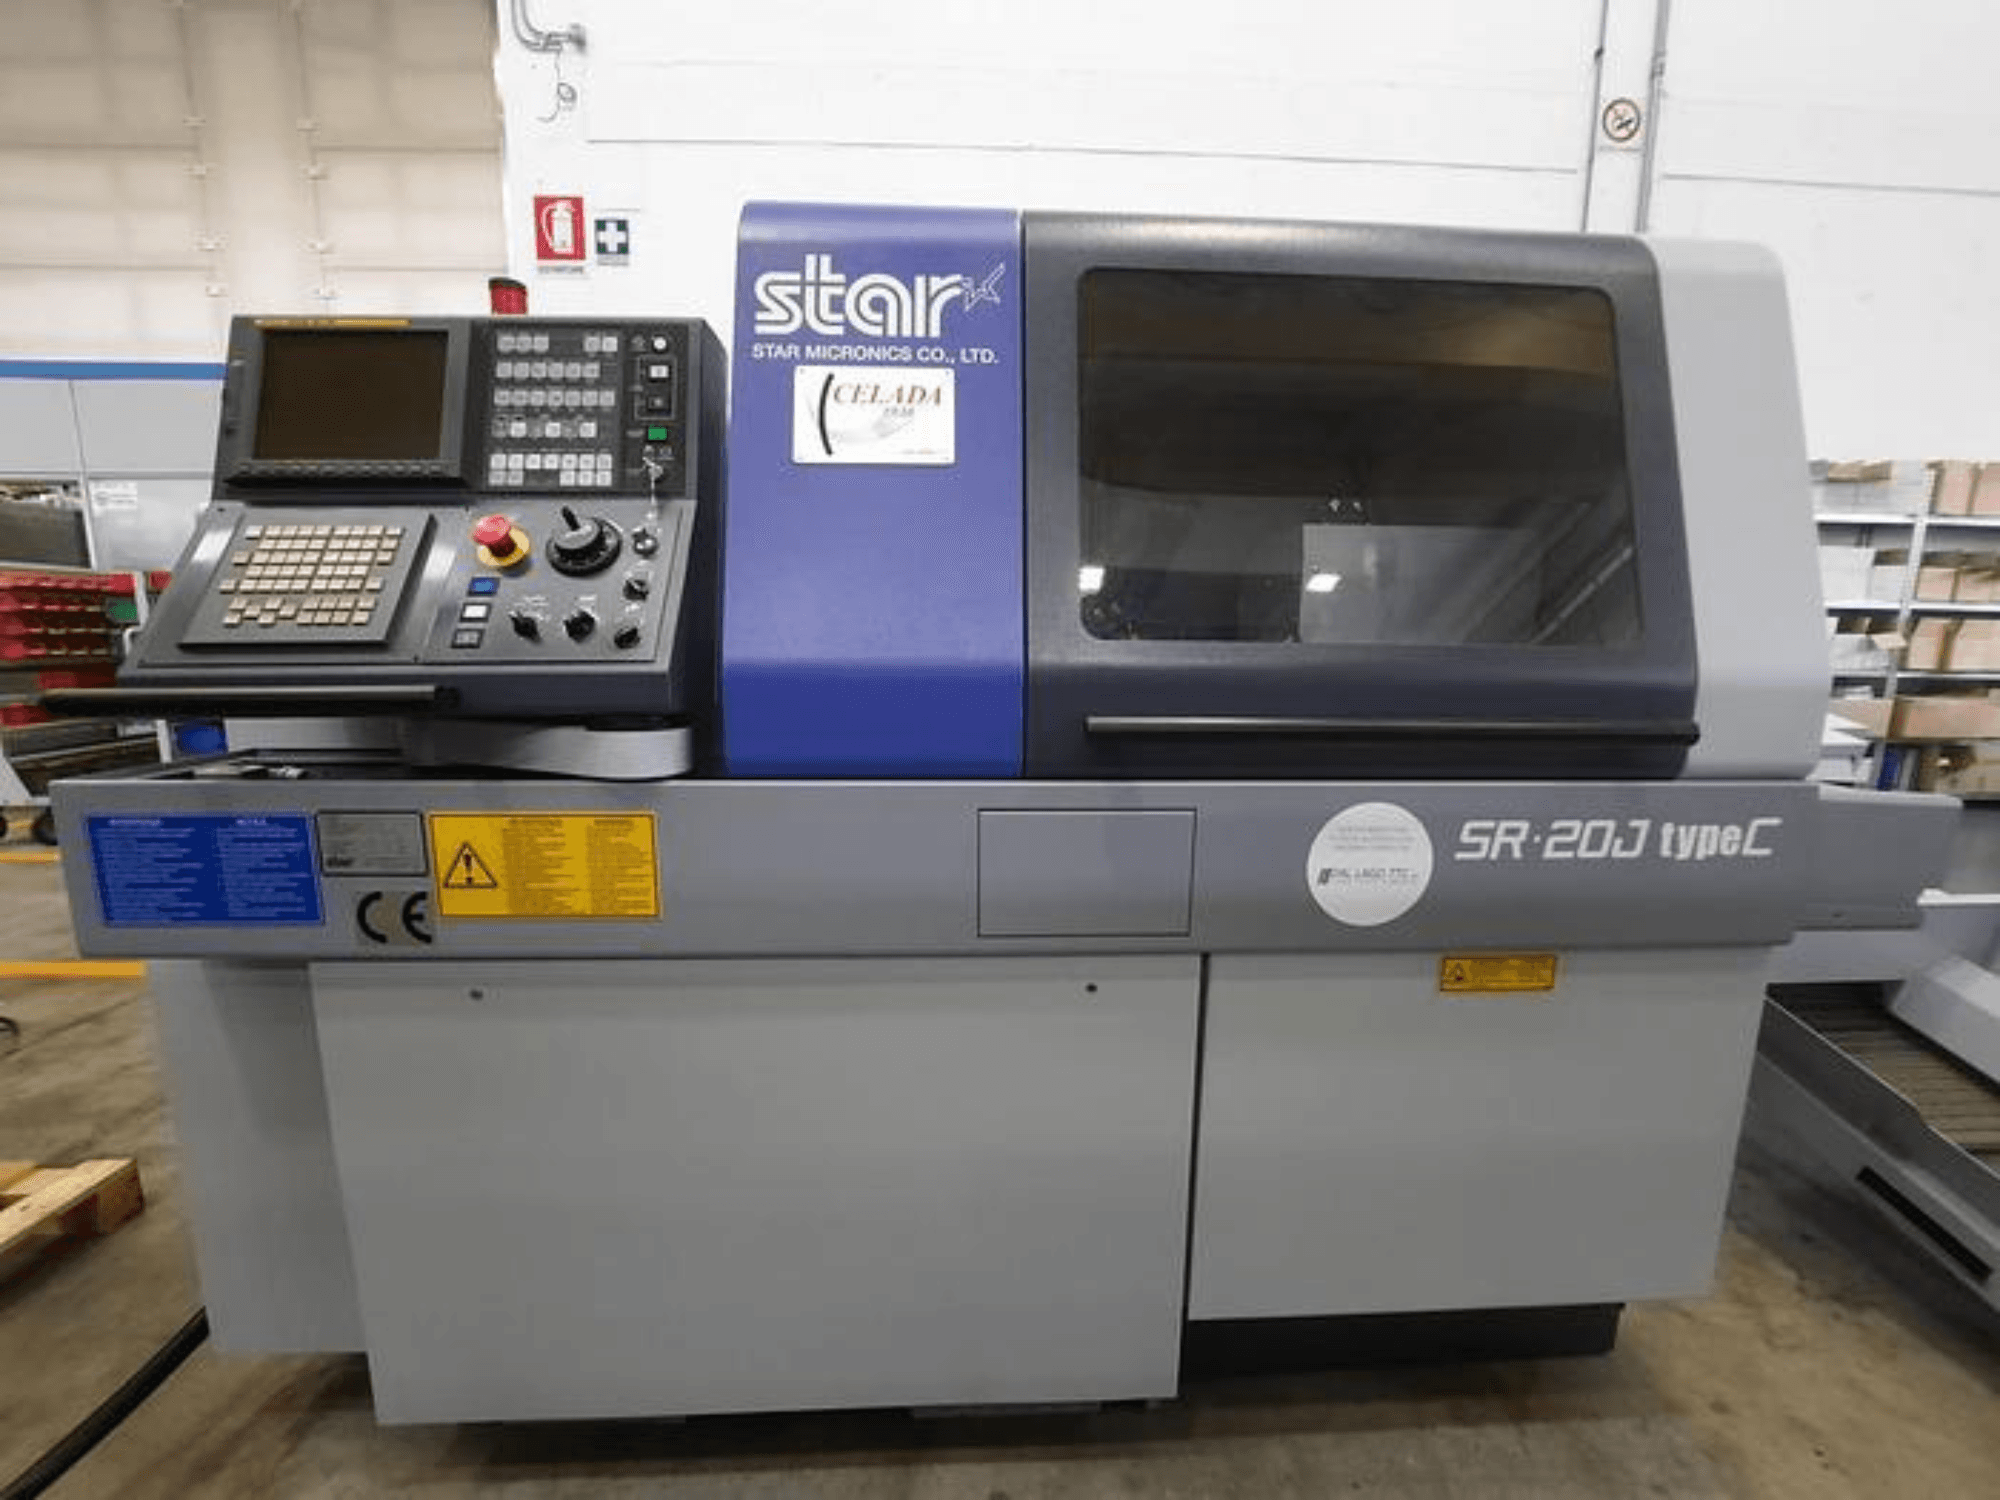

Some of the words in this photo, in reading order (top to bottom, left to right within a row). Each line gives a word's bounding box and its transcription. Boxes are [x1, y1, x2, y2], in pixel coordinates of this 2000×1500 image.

[754, 254, 962, 338] star
[752, 343, 800, 359] STAR
[804, 344, 912, 362] MICRONICS
[917, 346, 955, 364] CO.,
[960, 347, 999, 364] LTD.
[834, 382, 941, 406] CELADA
[357, 891, 432, 943] CE
